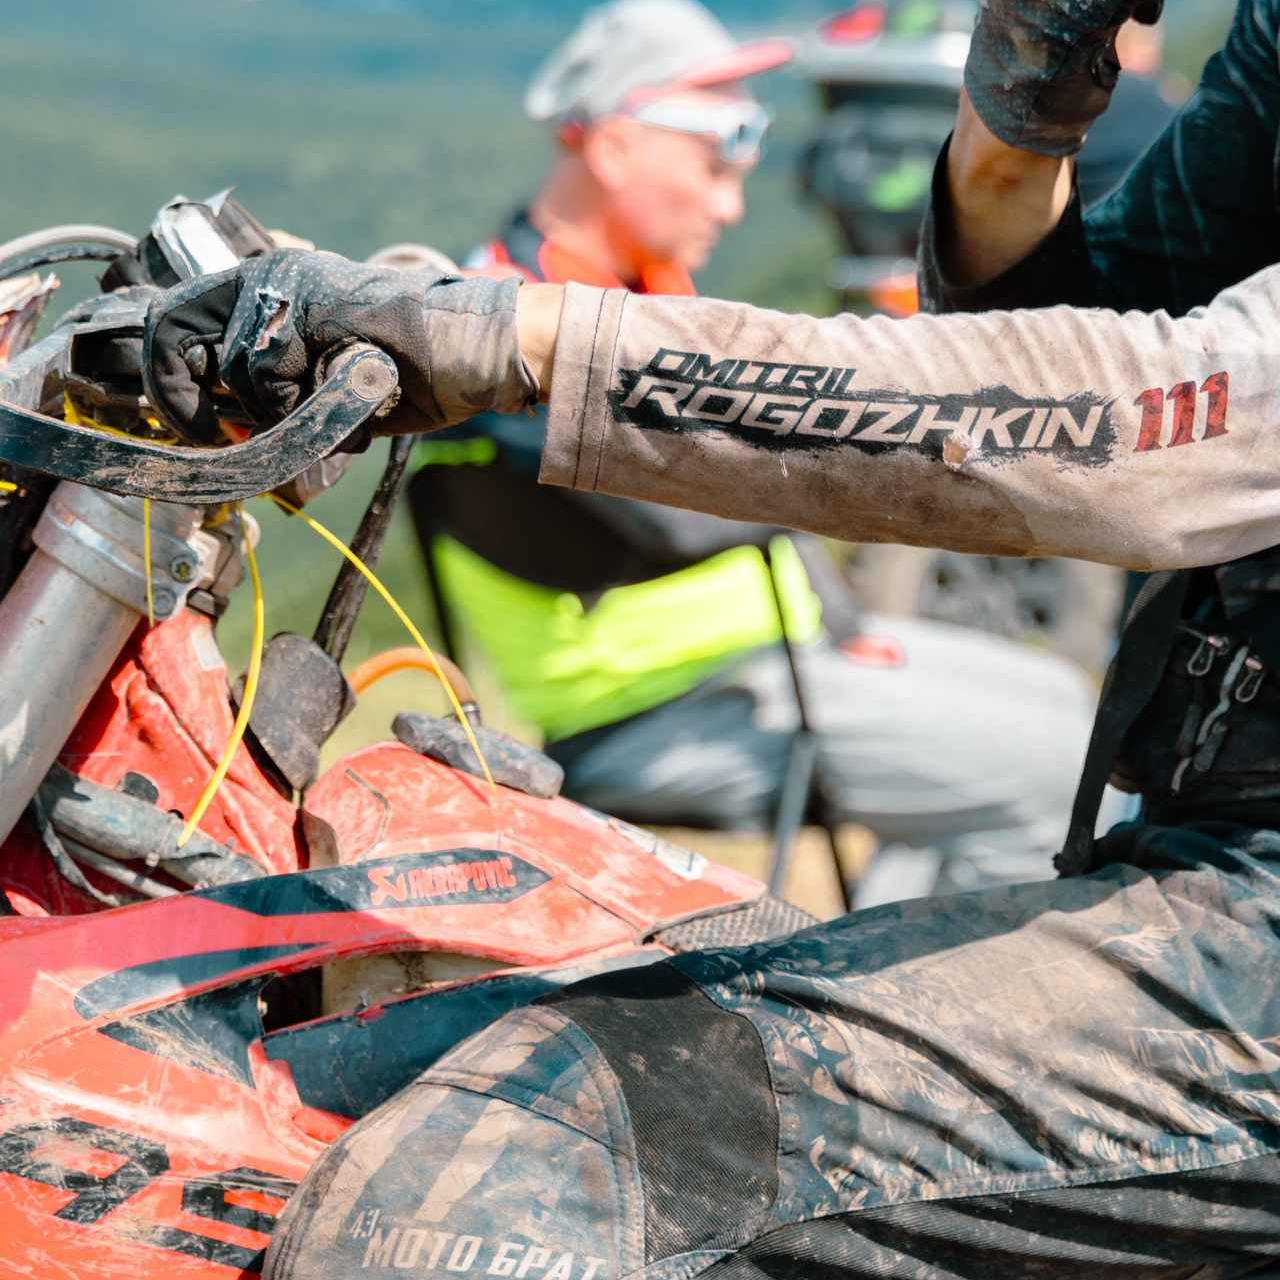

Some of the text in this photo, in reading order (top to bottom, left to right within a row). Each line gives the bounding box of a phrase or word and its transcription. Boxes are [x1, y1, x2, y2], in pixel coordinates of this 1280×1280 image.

[645, 347, 857, 394] DMITRII
[620, 370, 1231, 454] ROGOZHKIN 111
